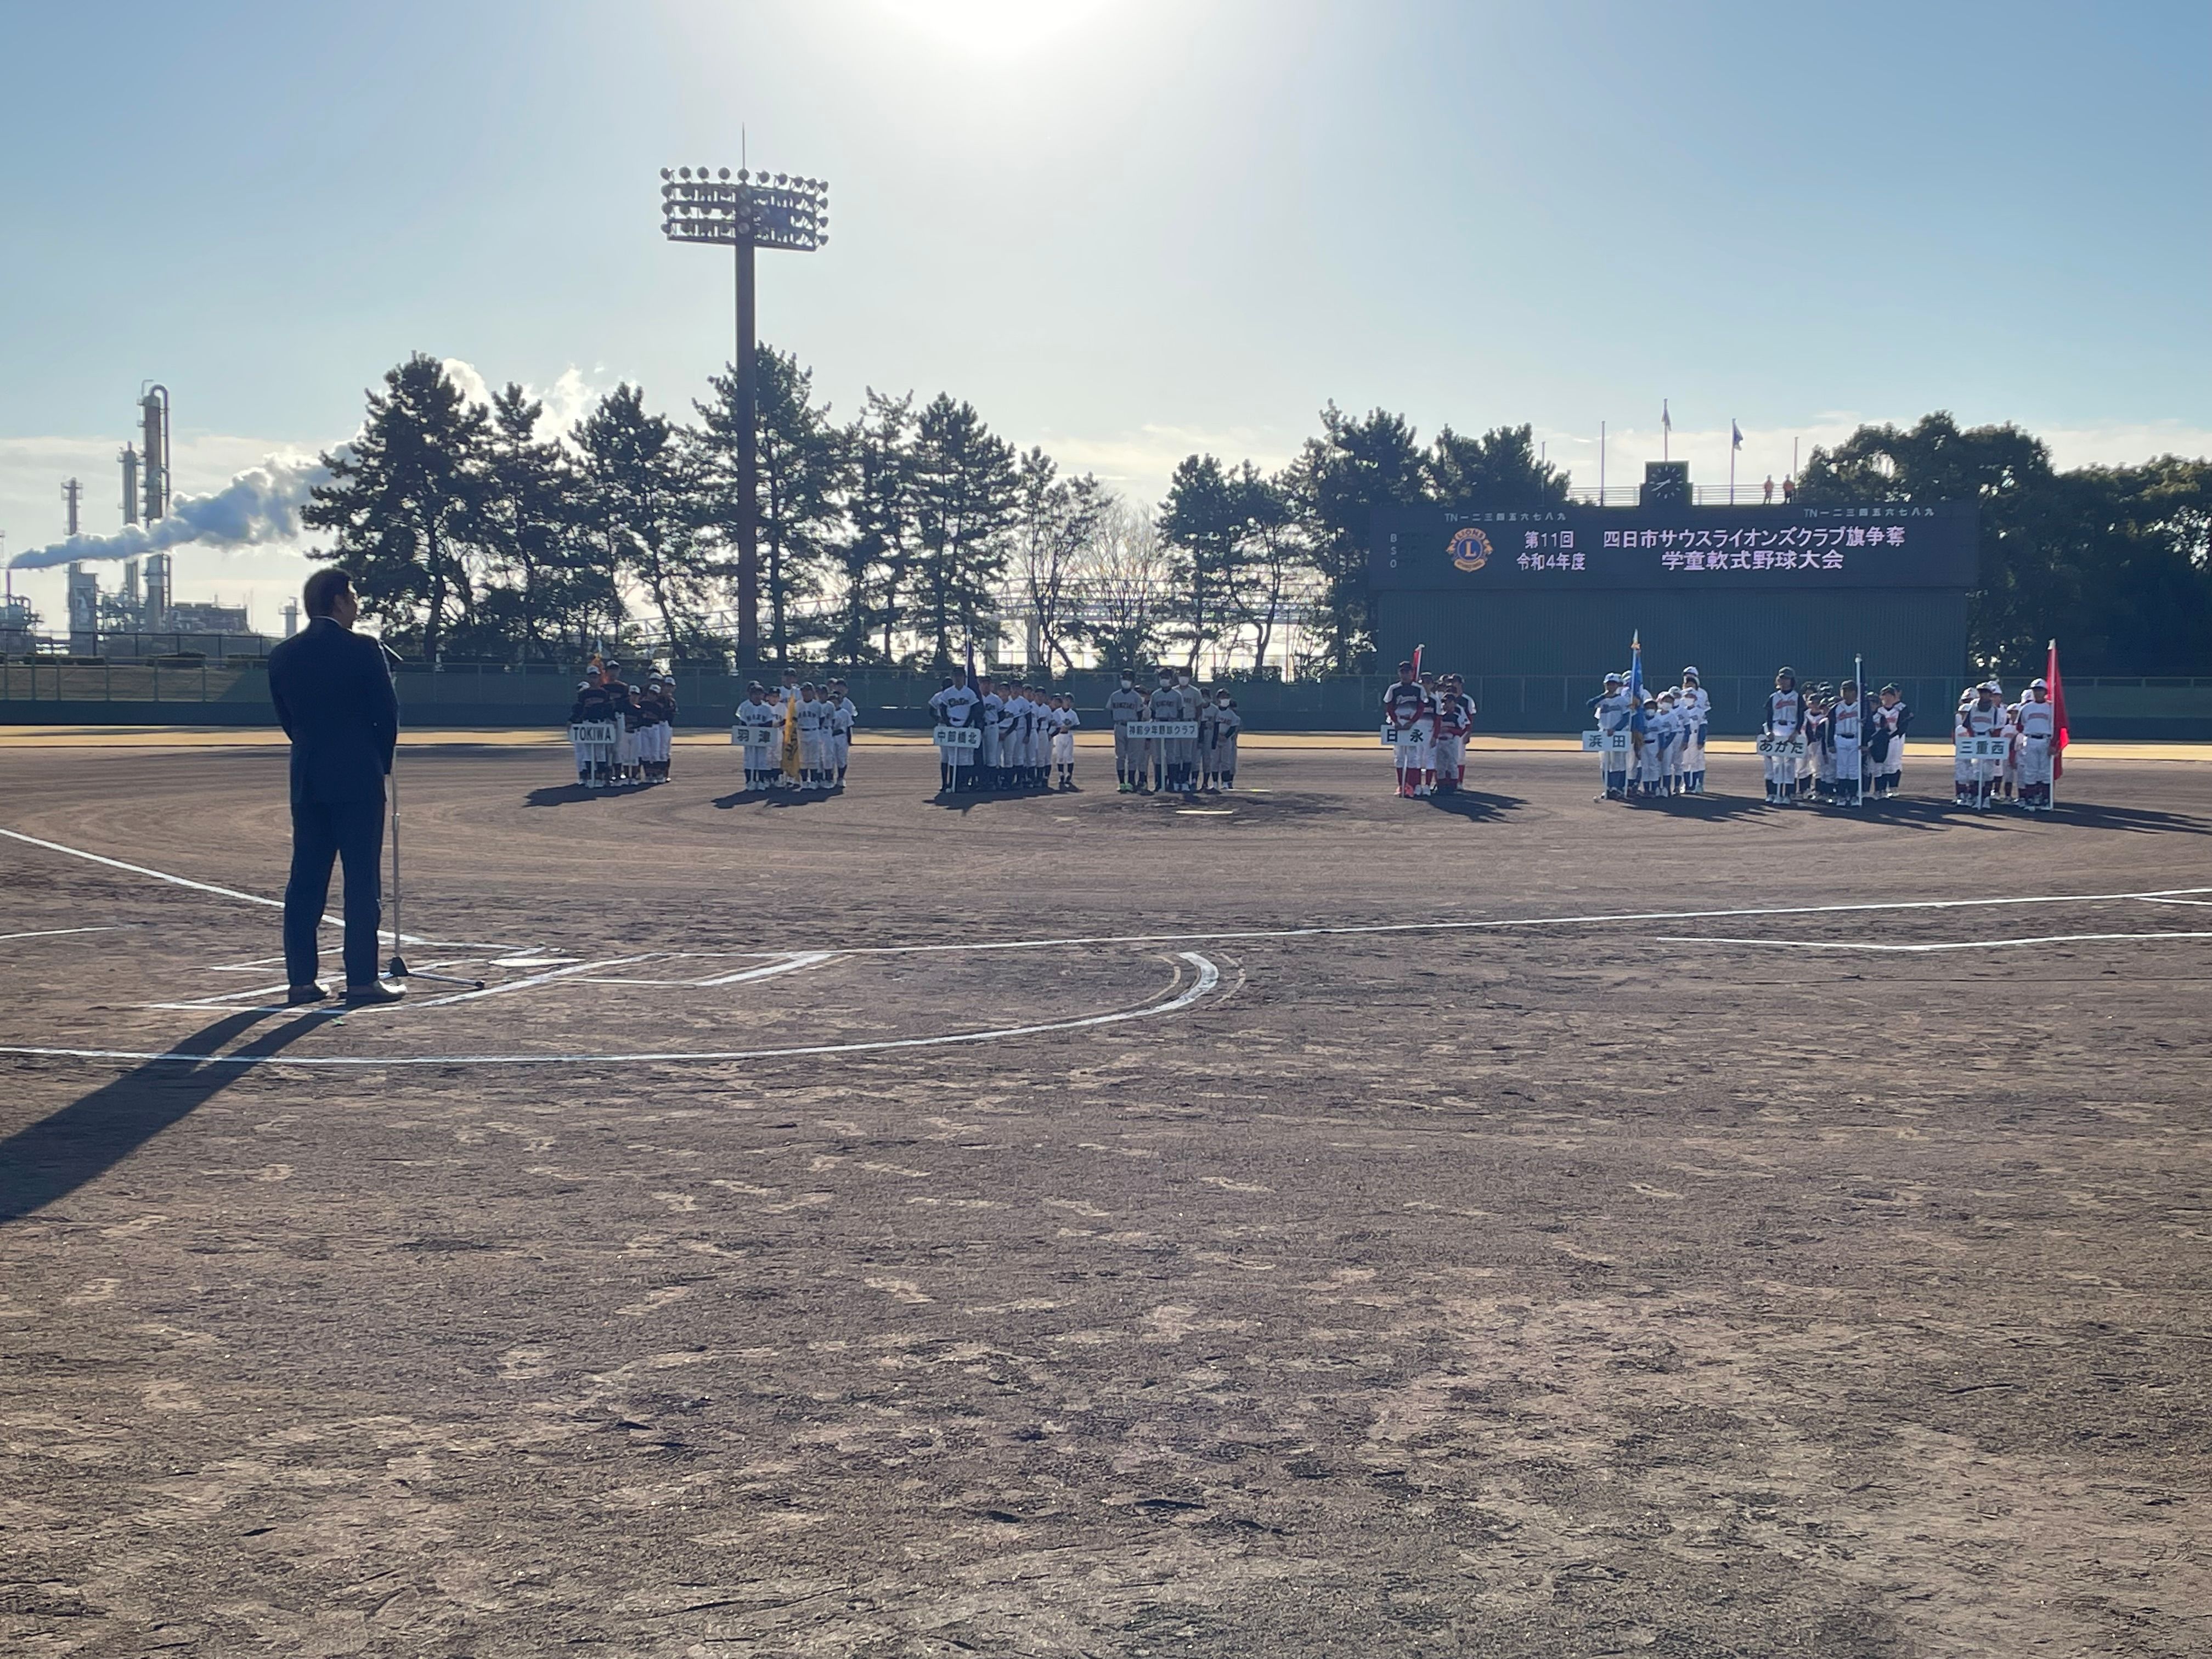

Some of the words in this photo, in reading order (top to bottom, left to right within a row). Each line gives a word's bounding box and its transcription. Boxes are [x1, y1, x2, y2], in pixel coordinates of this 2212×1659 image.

[1390, 533, 1397, 543] B
[1524, 530, 1575, 549] 第11回
[1603, 526, 1905, 548] 四日市サウスライオンズクラブ旗争奪
[1391, 546, 1397, 555] S
[1465, 541, 1477, 557] L
[1390, 559, 1397, 568] O
[1516, 552, 1586, 571] 令和4年度
[1661, 549, 1844, 571] 学童軟式野球大会
[573, 726, 611, 741] TOKIWA
[1387, 729, 1424, 742] 日永
[1589, 734, 1626, 748] 浜田
[1960, 741, 2004, 755] 三重西
